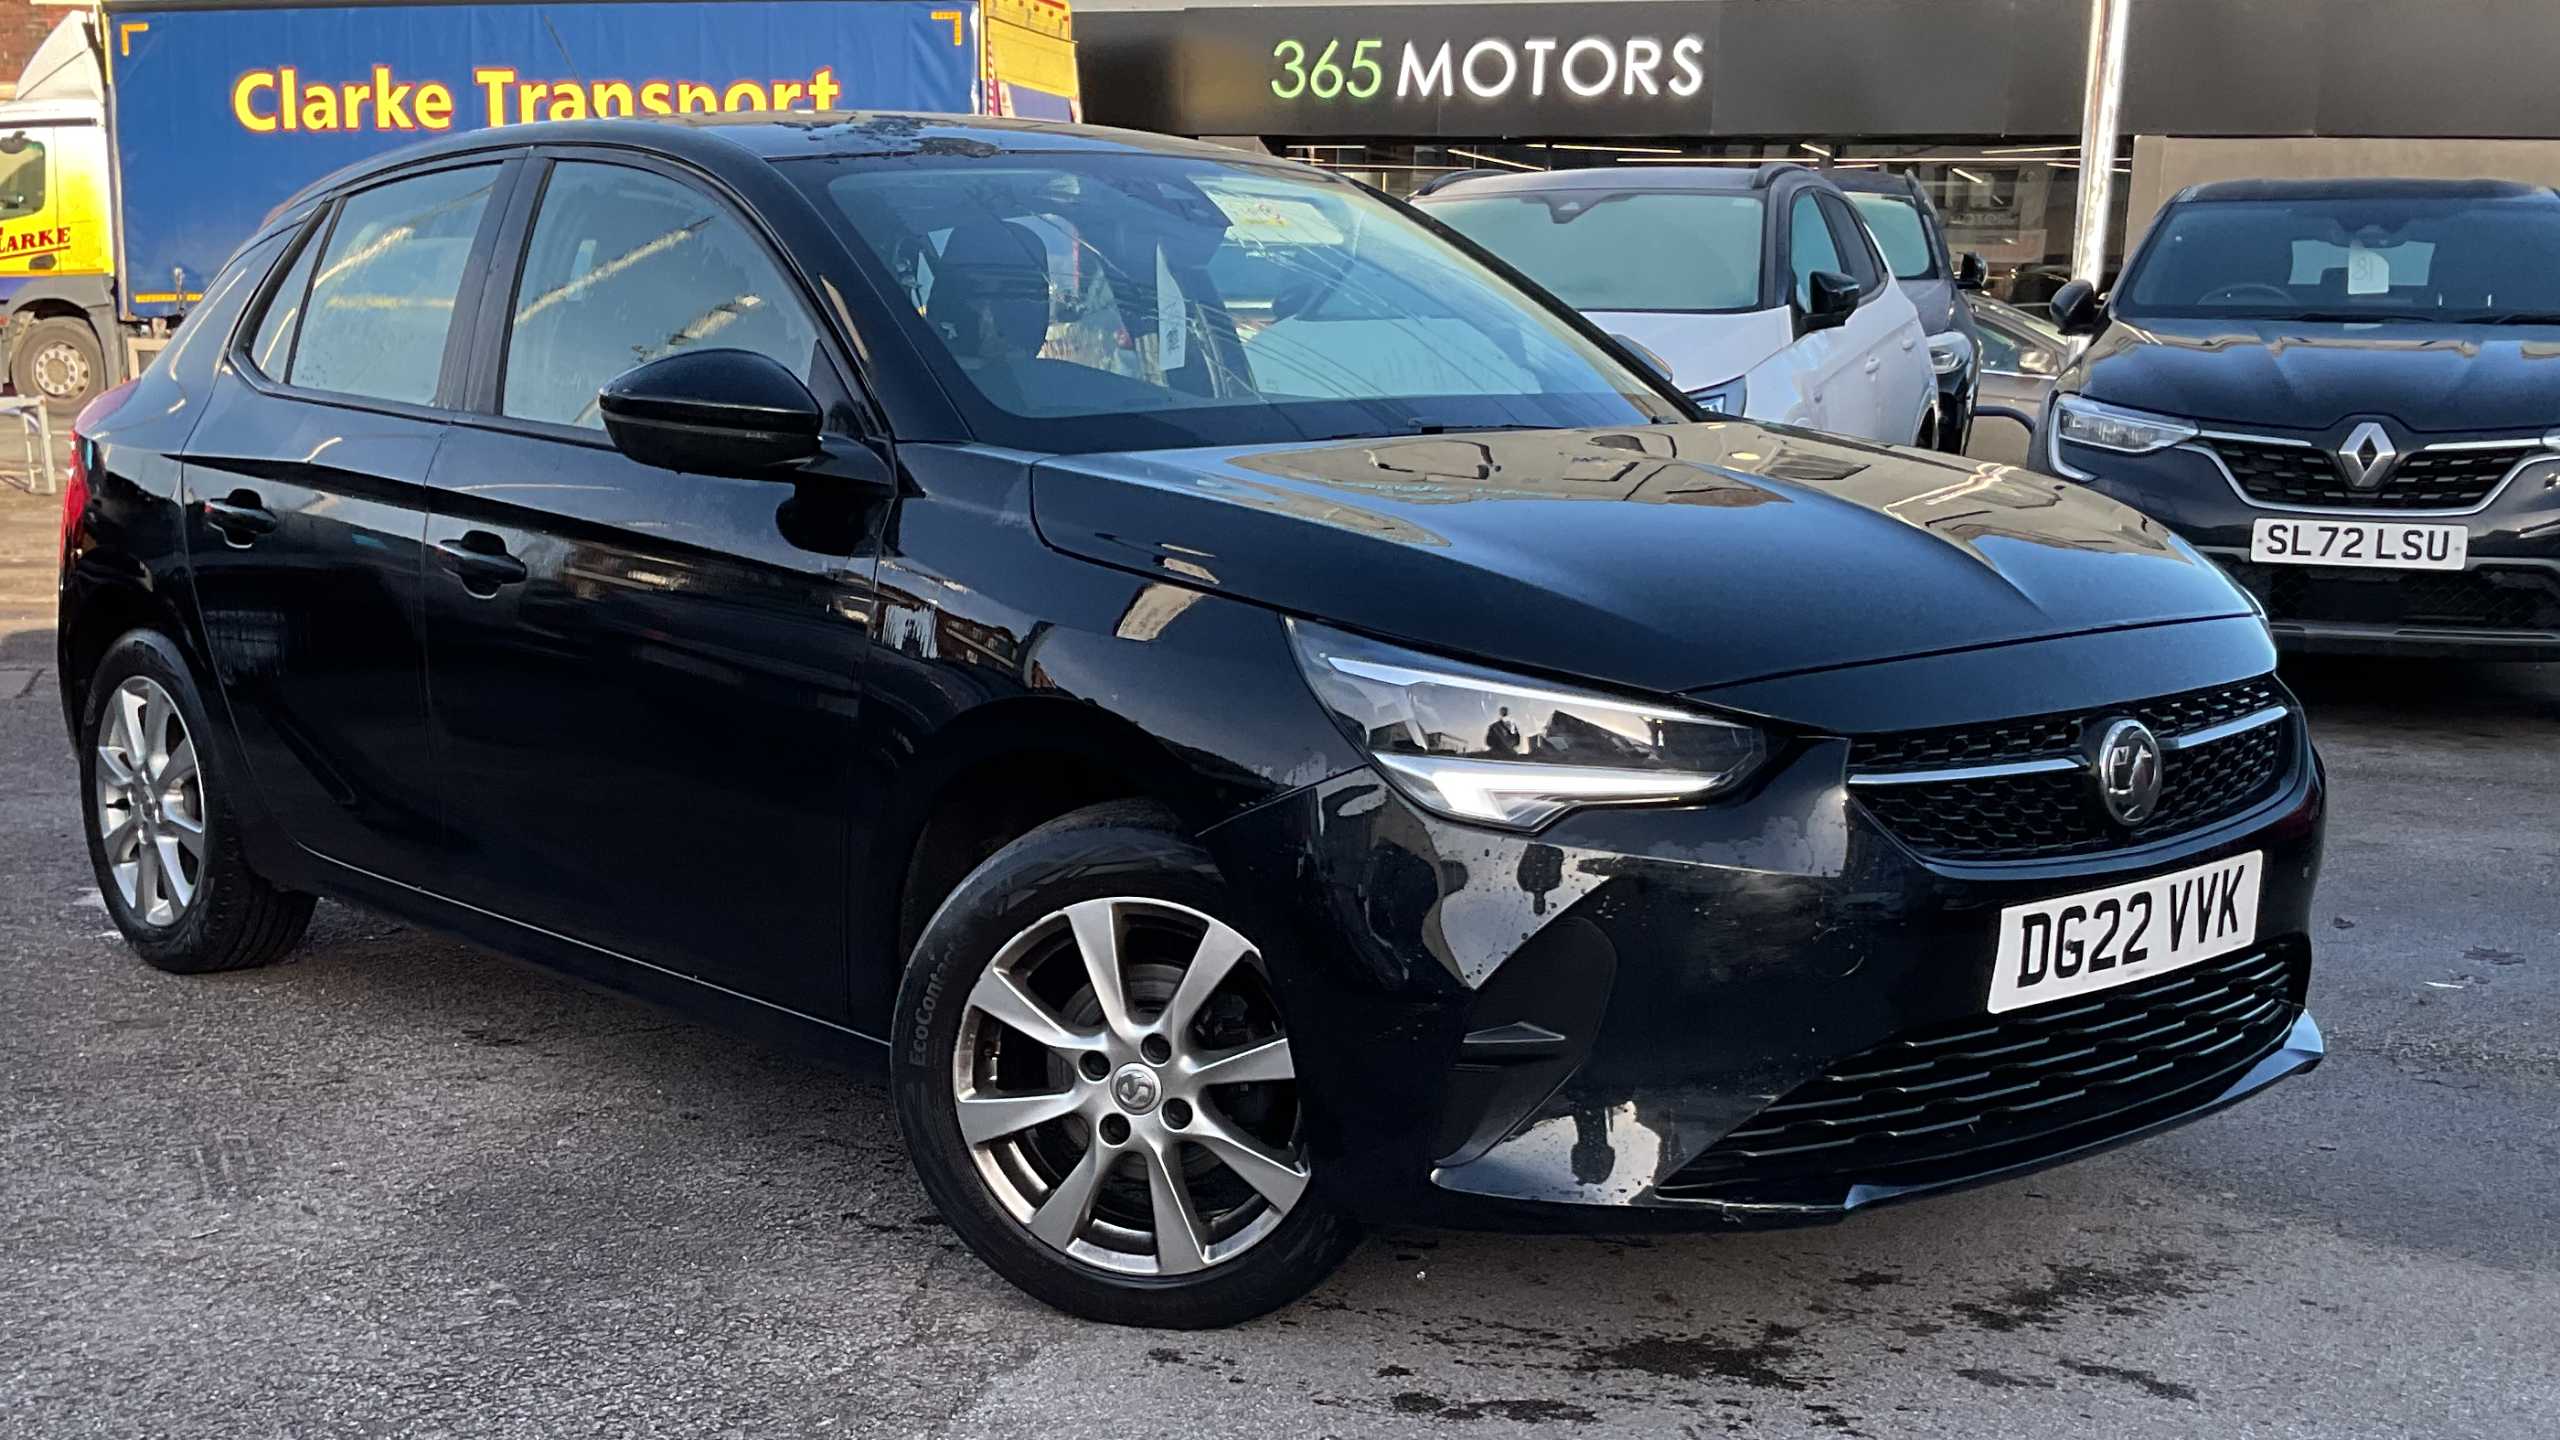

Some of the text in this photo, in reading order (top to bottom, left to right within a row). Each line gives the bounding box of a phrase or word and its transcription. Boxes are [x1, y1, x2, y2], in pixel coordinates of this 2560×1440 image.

[232, 65, 841, 132] Clarke Transport
[1270, 37, 1704, 99] 365 MOTORS
[0, 227, 70, 253] LARKE
[2266, 524, 2450, 561] SL72 LSU
[2017, 864, 2246, 988] DG22 VVK
